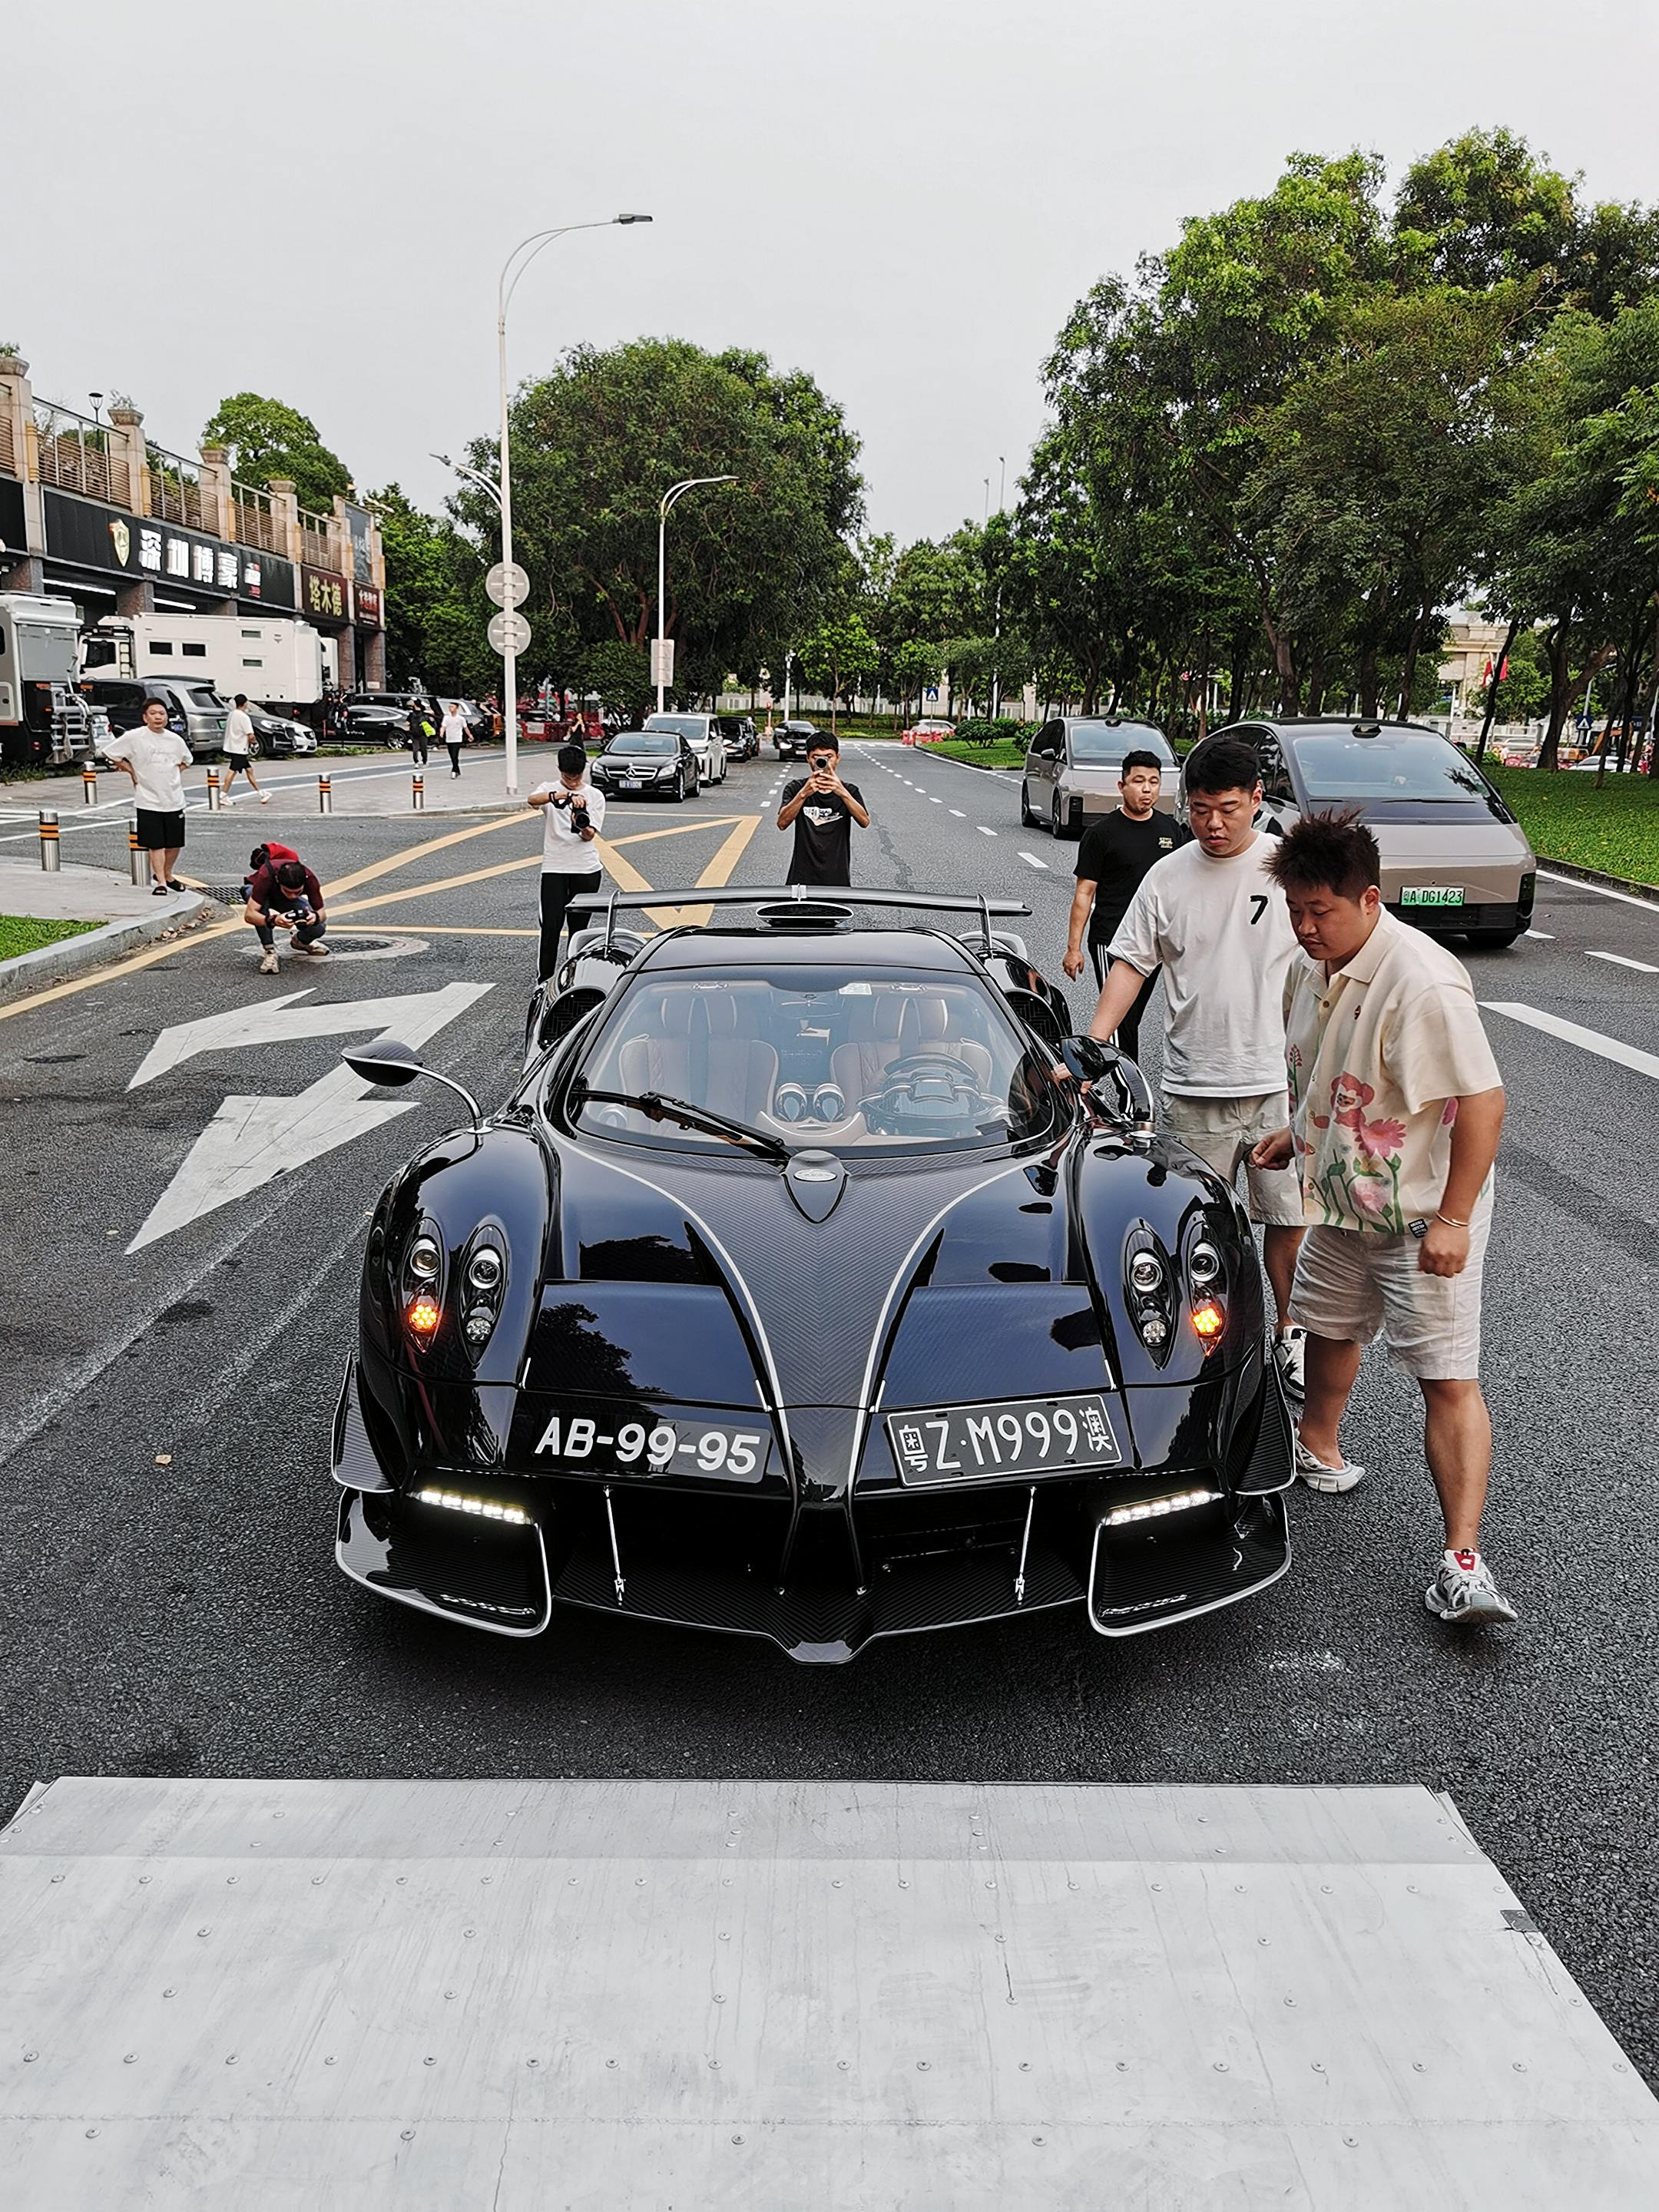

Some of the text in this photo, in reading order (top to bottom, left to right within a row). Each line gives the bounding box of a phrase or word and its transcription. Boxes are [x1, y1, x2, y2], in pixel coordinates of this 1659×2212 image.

[139, 528, 237, 589] 深圳博豪
[1250, 895, 1268, 925] 7
[535, 1417, 760, 1475] AB-99-95
